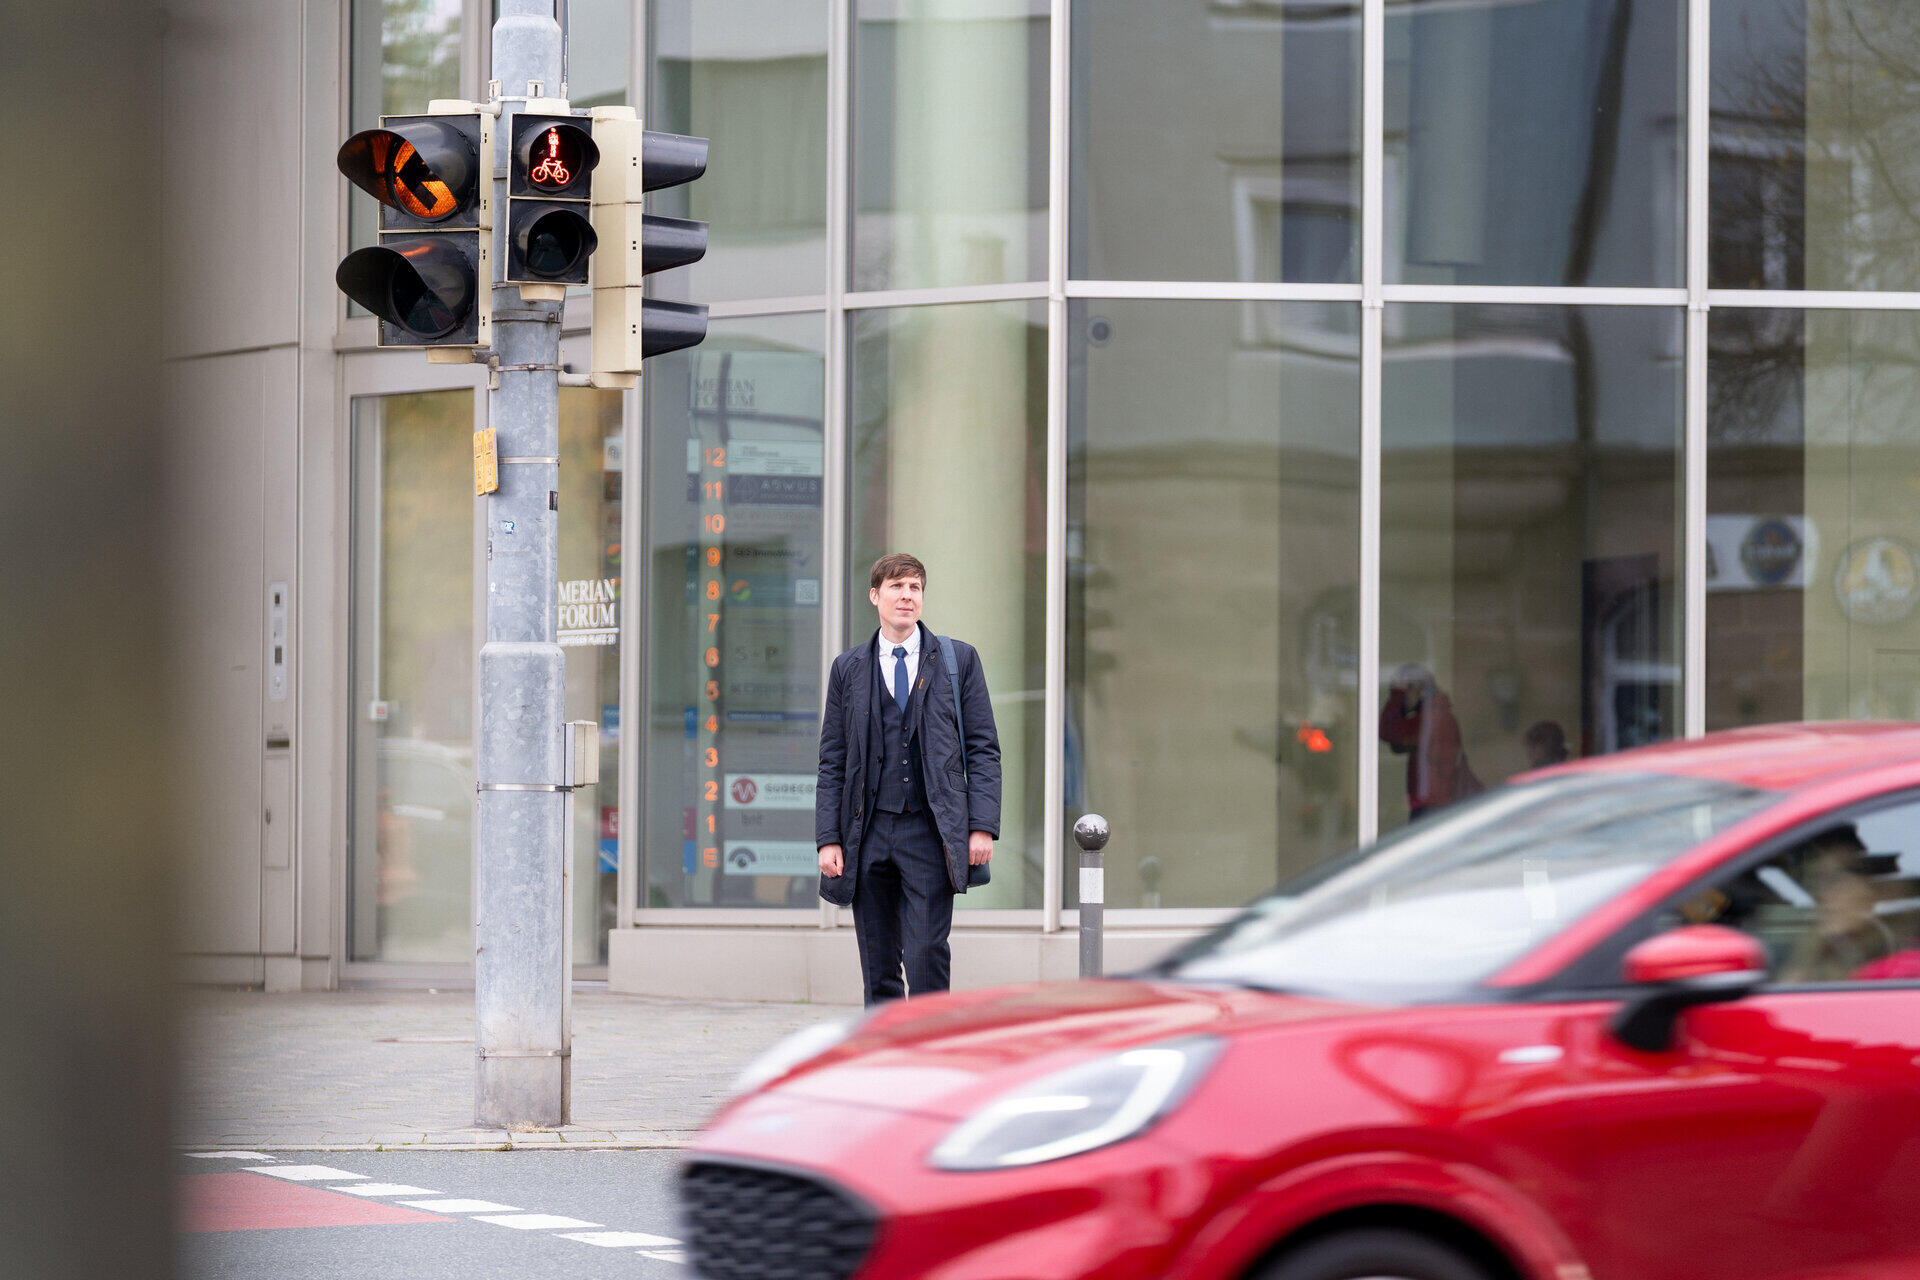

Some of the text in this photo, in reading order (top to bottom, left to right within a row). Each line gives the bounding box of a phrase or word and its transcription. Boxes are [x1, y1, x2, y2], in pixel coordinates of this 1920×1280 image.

[696, 379, 756, 392] MEIAN
[696, 393, 756, 408] FOUM
[704, 447, 726, 467] 12
[704, 481, 722, 500] 11
[704, 513, 726, 534] 10
[707, 547, 720, 567] 9
[557, 578, 616, 605] MERIAN
[706, 579, 720, 600] 8
[557, 602, 617, 629] FORUM
[707, 613, 720, 633] 7
[705, 647, 719, 668] 6
[706, 680, 719, 701] 5
[704, 714, 718, 734] 4
[705, 747, 718, 768] 3
[704, 780, 718, 801] 2
[706, 813, 716, 834] 1
[704, 847, 718, 868] E
